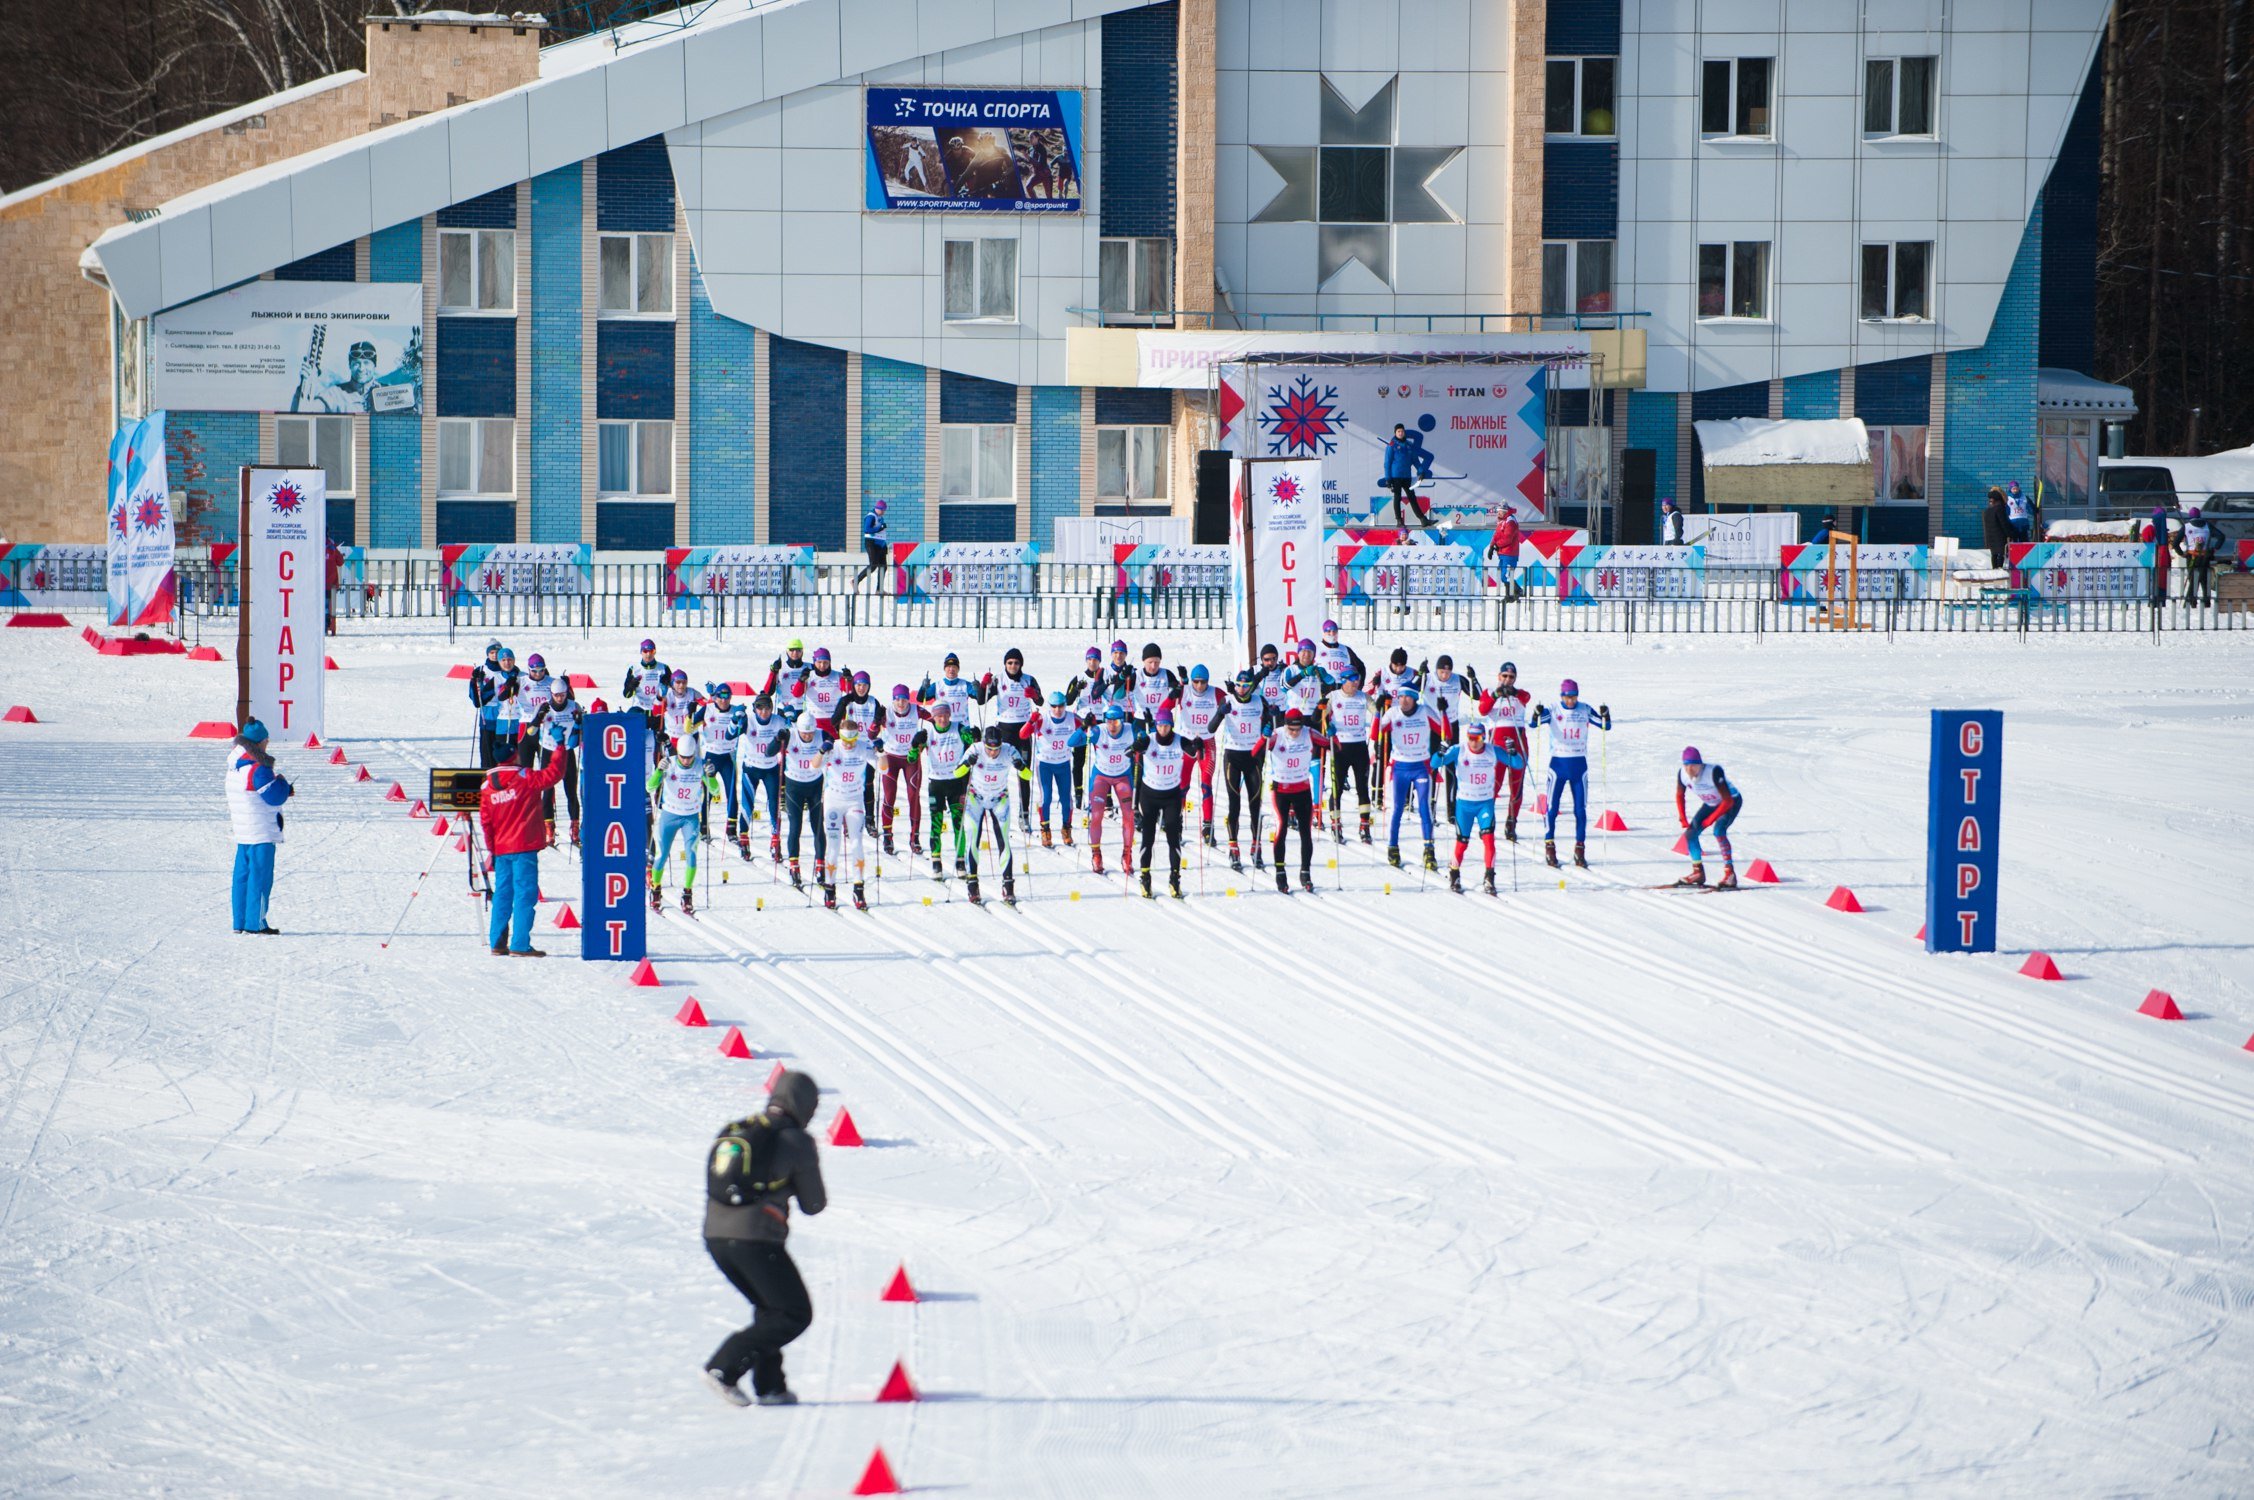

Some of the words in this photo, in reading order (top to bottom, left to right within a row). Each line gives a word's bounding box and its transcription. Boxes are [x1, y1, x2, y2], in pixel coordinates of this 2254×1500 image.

[922, 101, 978, 117] ТОЧКА
[984, 103, 1051, 118] СПОРТА
[896, 200, 980, 208] WWW.SPORTPUNKT.RU
[1023, 201, 1068, 210] @sportpunkt
[251, 311, 293, 319] ЛЫЖНОЙ
[304, 312, 328, 320] ВЕЛО
[330, 312, 390, 321] ЭКИПИРОВКИ
[1447, 385, 1485, 397] TITAN
[1450, 415, 1507, 430] ЛЫЖНЫЕ
[1469, 434, 1507, 449] ГОНКИ
[1455, 513, 1461, 524] 2
[278, 551, 295, 729] СТАРТ
[1328, 661, 1344, 671] 108
[644, 685, 656, 696] 84
[1265, 687, 1278, 697] 99
[817, 692, 830, 703] 96
[1008, 696, 1021, 708] 97
[1145, 693, 1162, 704] 167
[1191, 714, 1208, 725] 159
[1343, 715, 1360, 726] 156
[1239, 722, 1252, 734] 81
[1562, 727, 1581, 740] 114
[895, 733, 911, 744] 160
[1402, 733, 1420, 745] 157
[1051, 740, 1065, 751] 93
[1109, 754, 1122, 764] 89
[1286, 757, 1300, 768] 90
[1155, 764, 1174, 775] 110
[841, 771, 855, 783] 85
[984, 774, 998, 783] 94
[1469, 773, 1487, 785] 158
[677, 787, 691, 800] 82
[1957, 720, 1984, 946] СТАРТ
[603, 724, 629, 956] СТАРТ
